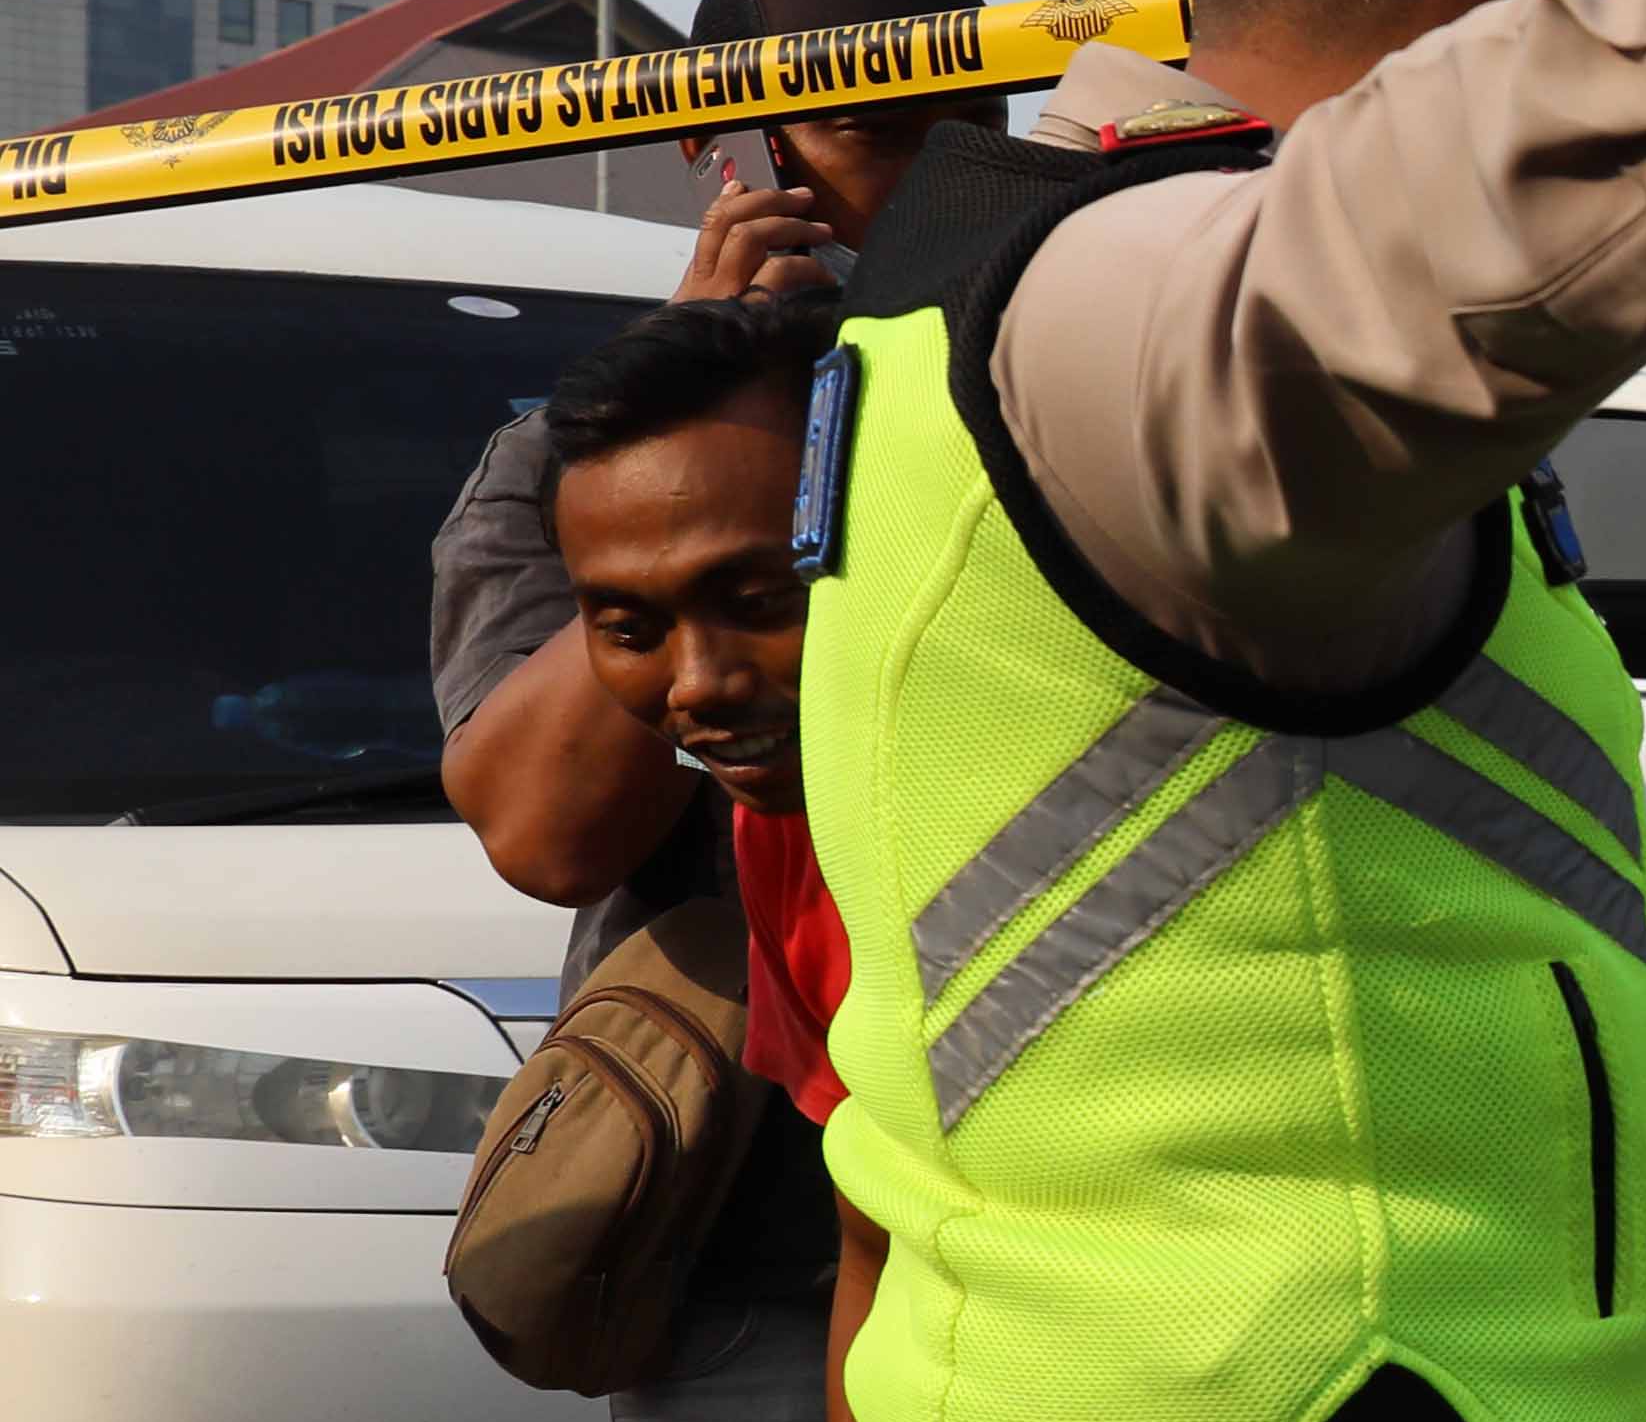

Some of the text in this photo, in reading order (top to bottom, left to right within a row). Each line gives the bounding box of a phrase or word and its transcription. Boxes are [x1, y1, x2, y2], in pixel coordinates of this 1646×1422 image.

[272, 7, 984, 166] DILARANG MELINTAS GARIS POLISI
